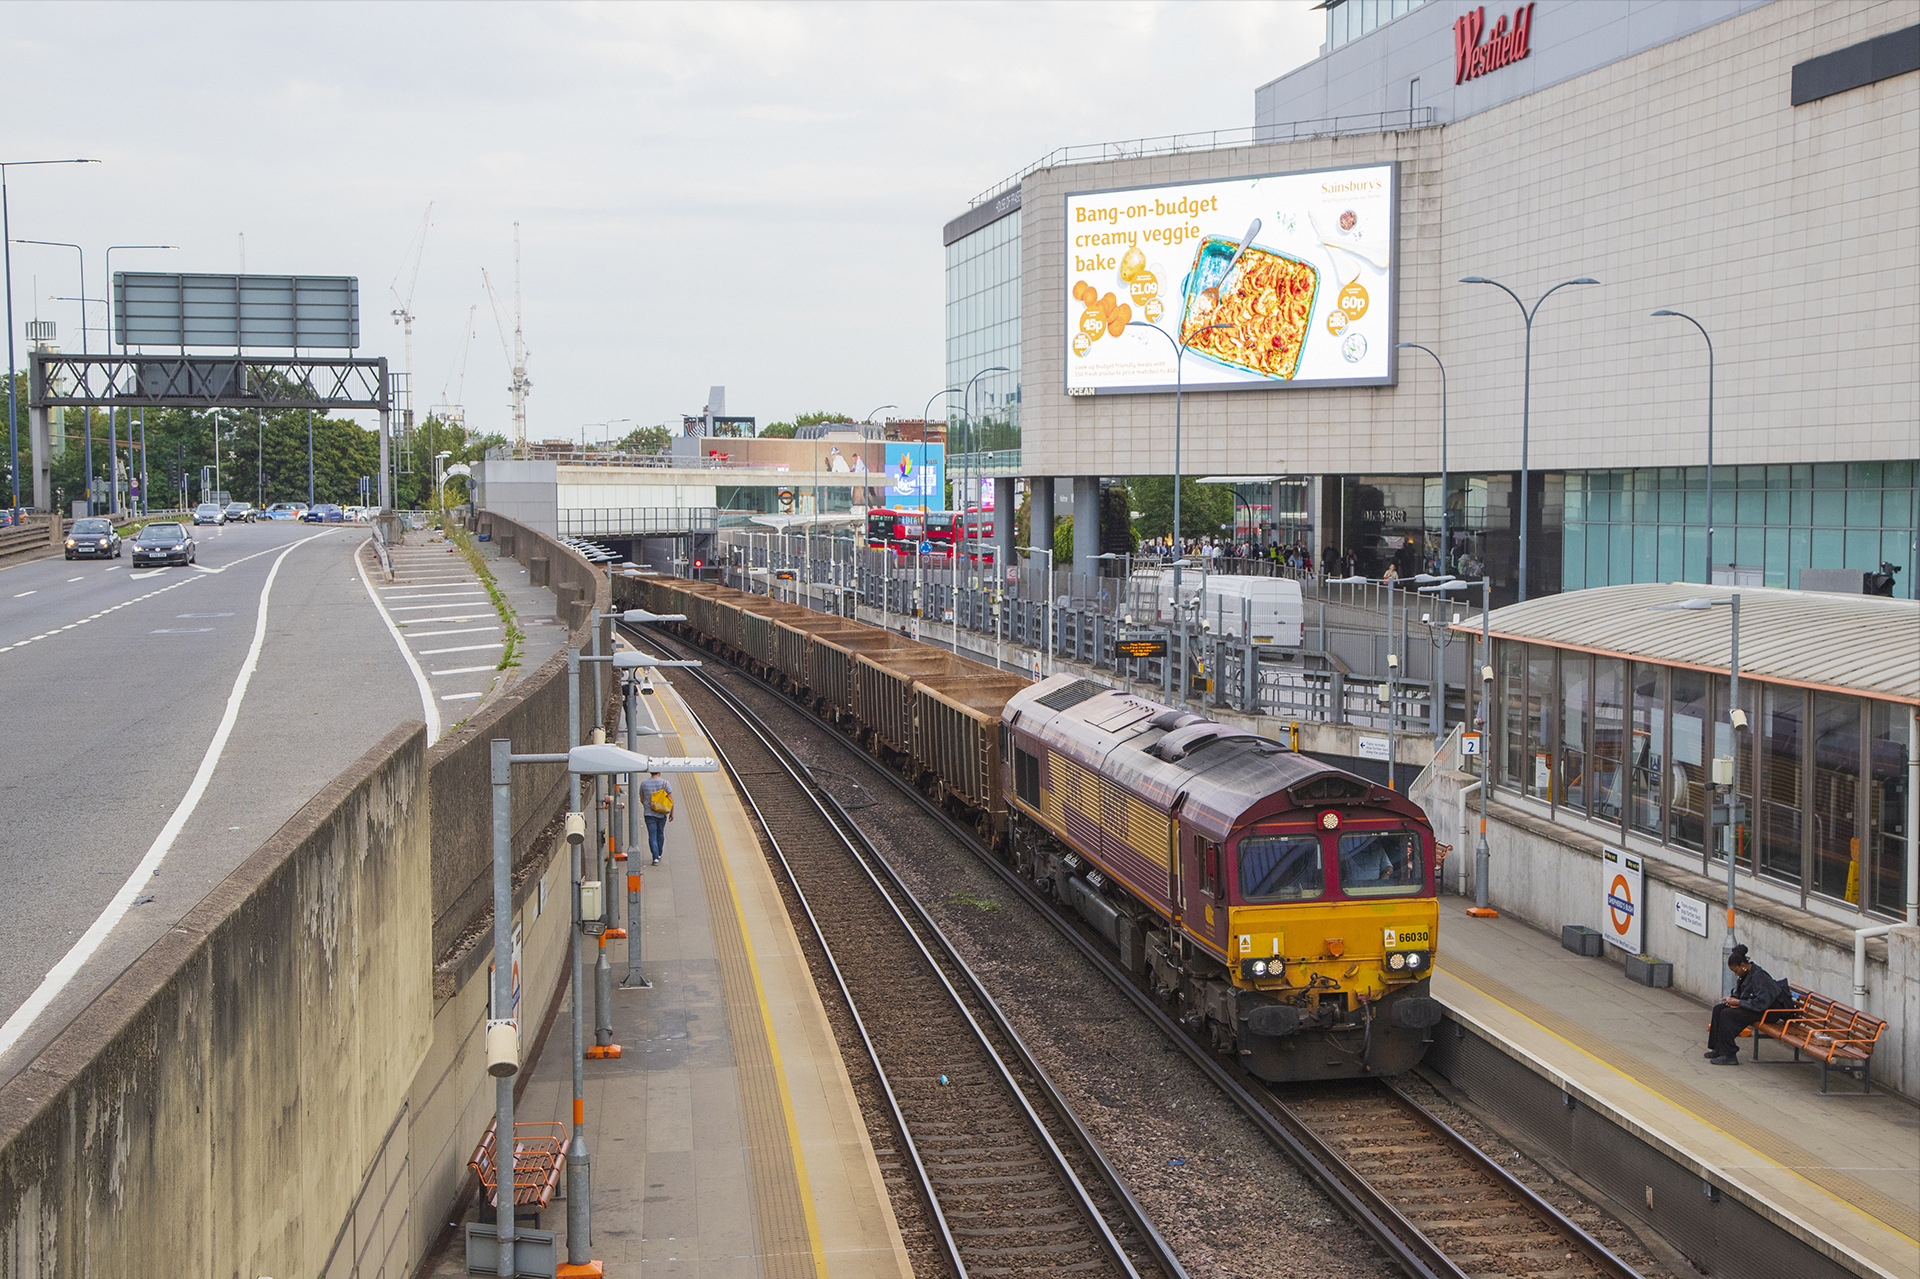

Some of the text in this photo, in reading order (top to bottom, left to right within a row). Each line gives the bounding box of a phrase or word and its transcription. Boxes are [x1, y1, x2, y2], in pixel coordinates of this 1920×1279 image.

[1453, 2, 1535, 85] Westfield
[1321, 178, 1382, 194] Sainsbury's
[1075, 195, 1218, 225] Bang-on-budget
[1075, 221, 1200, 249] creamy veggie
[1075, 254, 1116, 272] bake
[1130, 282, 1158, 295] £1.09
[1342, 296, 1365, 312] 60p
[1083, 319, 1103, 333] 45p
[1068, 387, 1095, 396] OCEAN
[1467, 741, 1475, 752] 2
[1064, 762, 1129, 841] EWS 66030
[1399, 931, 1429, 943] 66030
